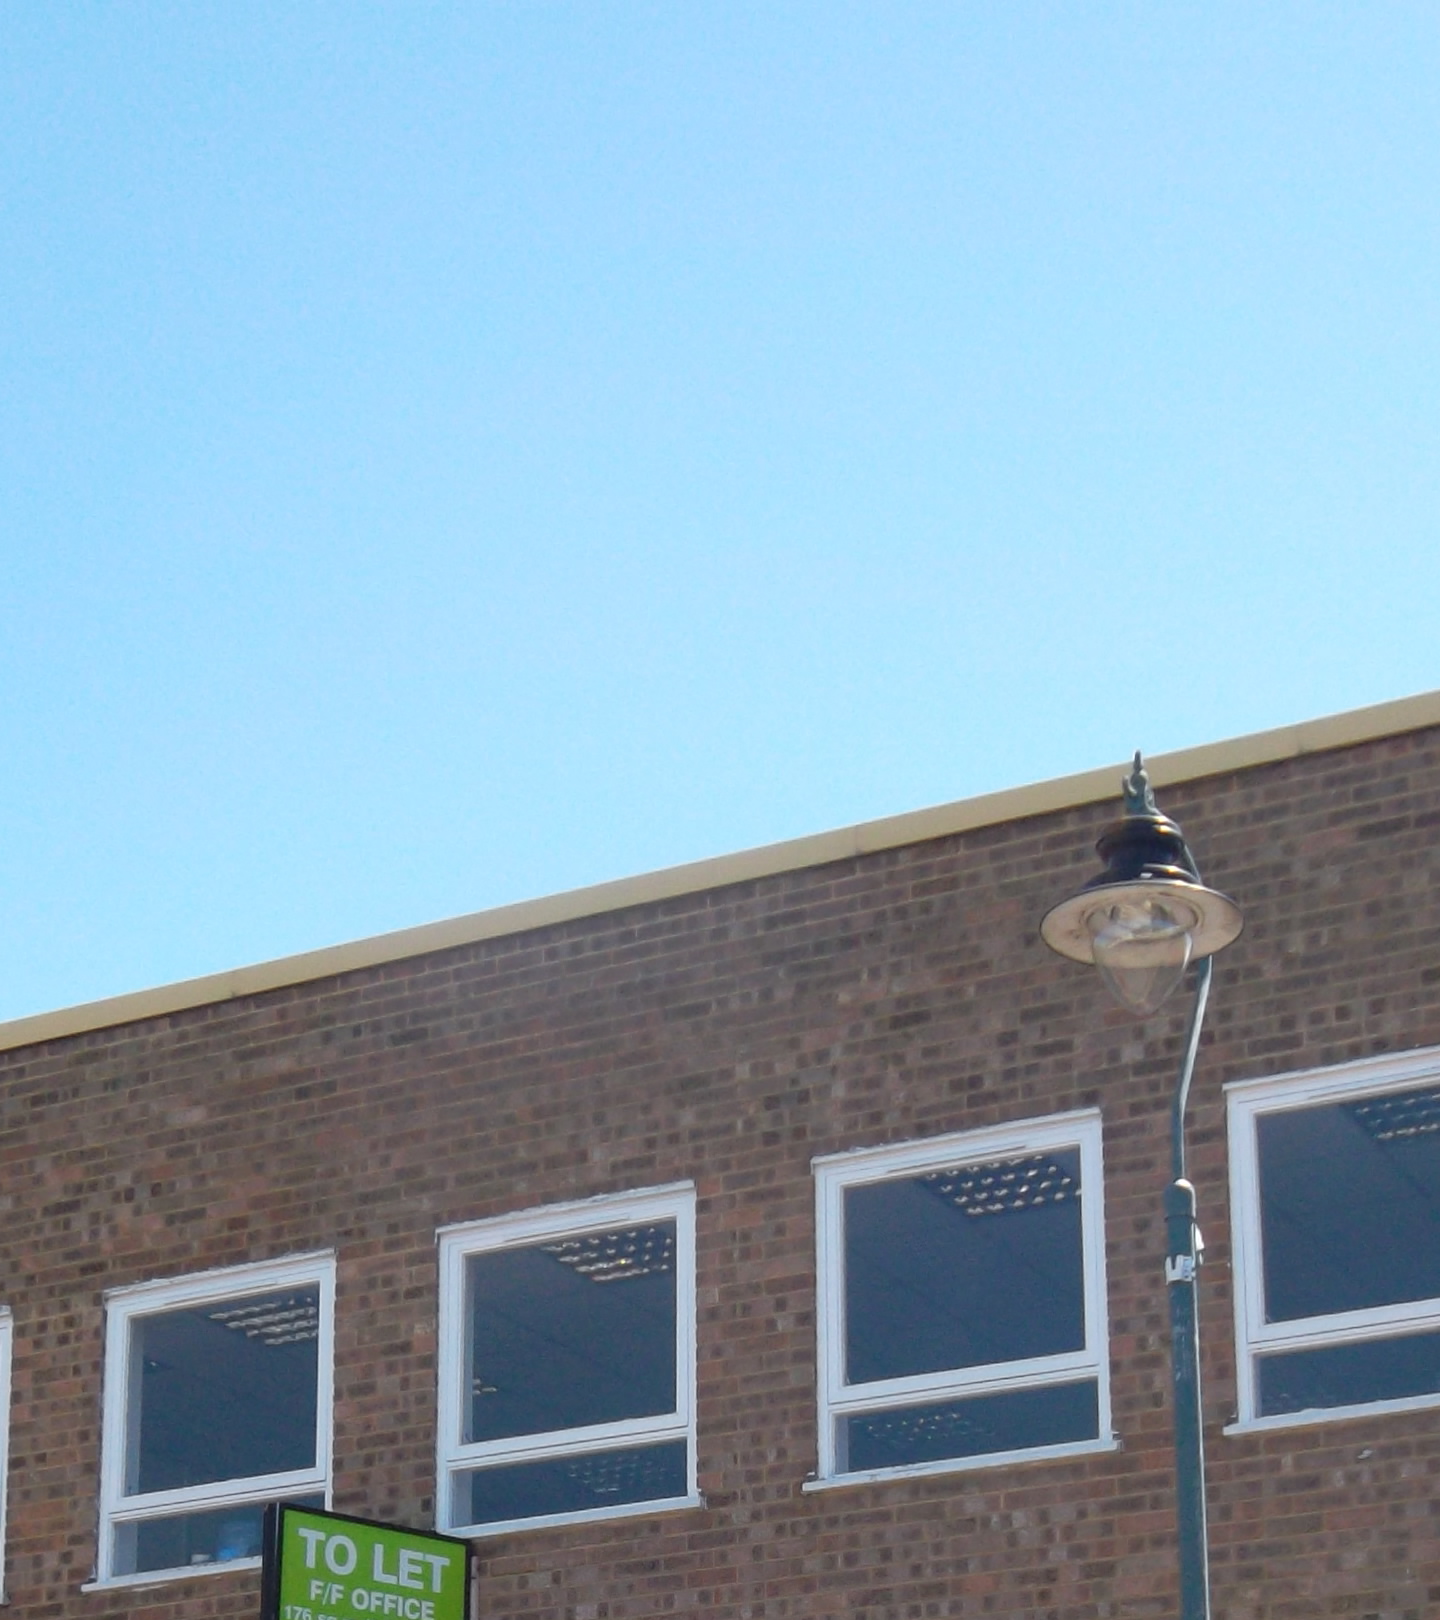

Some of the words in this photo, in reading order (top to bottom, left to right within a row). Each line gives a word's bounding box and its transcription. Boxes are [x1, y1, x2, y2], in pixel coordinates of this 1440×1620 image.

[298, 1527, 357, 1575] TO
[372, 1543, 450, 1594] LET
[310, 1579, 344, 1606] F/F
